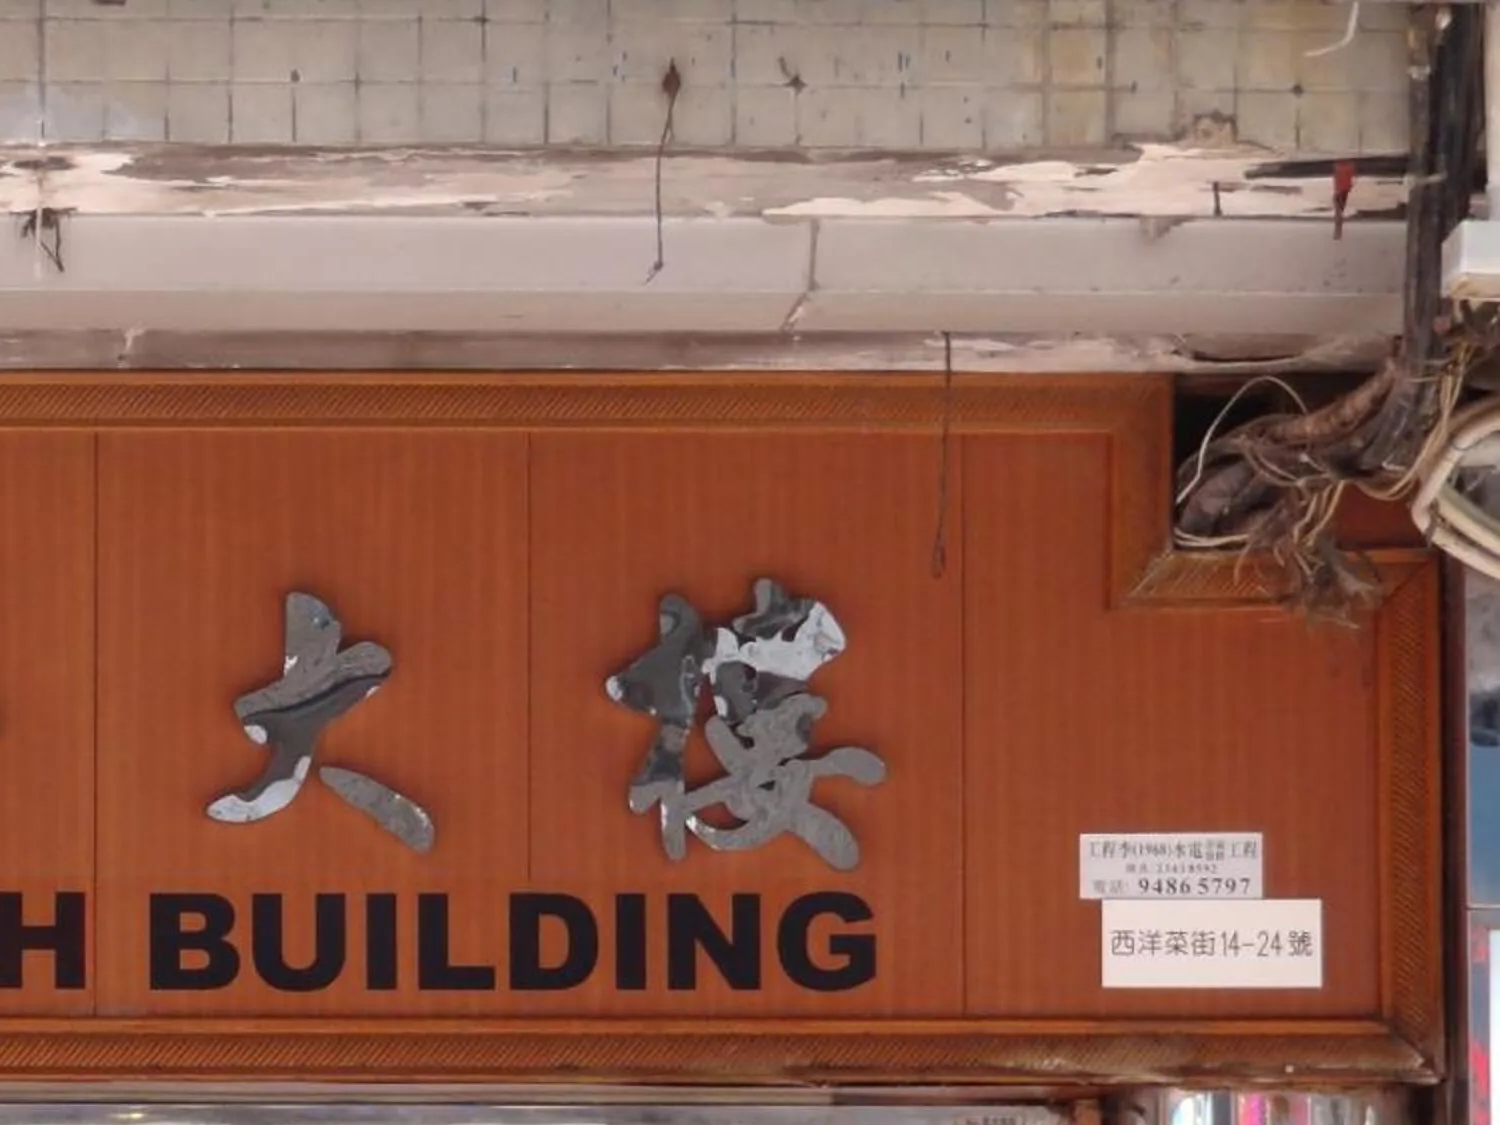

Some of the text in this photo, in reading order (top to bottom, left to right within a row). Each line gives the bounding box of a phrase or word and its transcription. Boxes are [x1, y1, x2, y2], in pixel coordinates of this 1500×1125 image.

[1138, 877, 1191, 894] 9486
[1198, 877, 1251, 894] 5797
[149, 891, 877, 992] BUILDING
[1110, 929, 1314, 958] 西洋菜街14-24號
